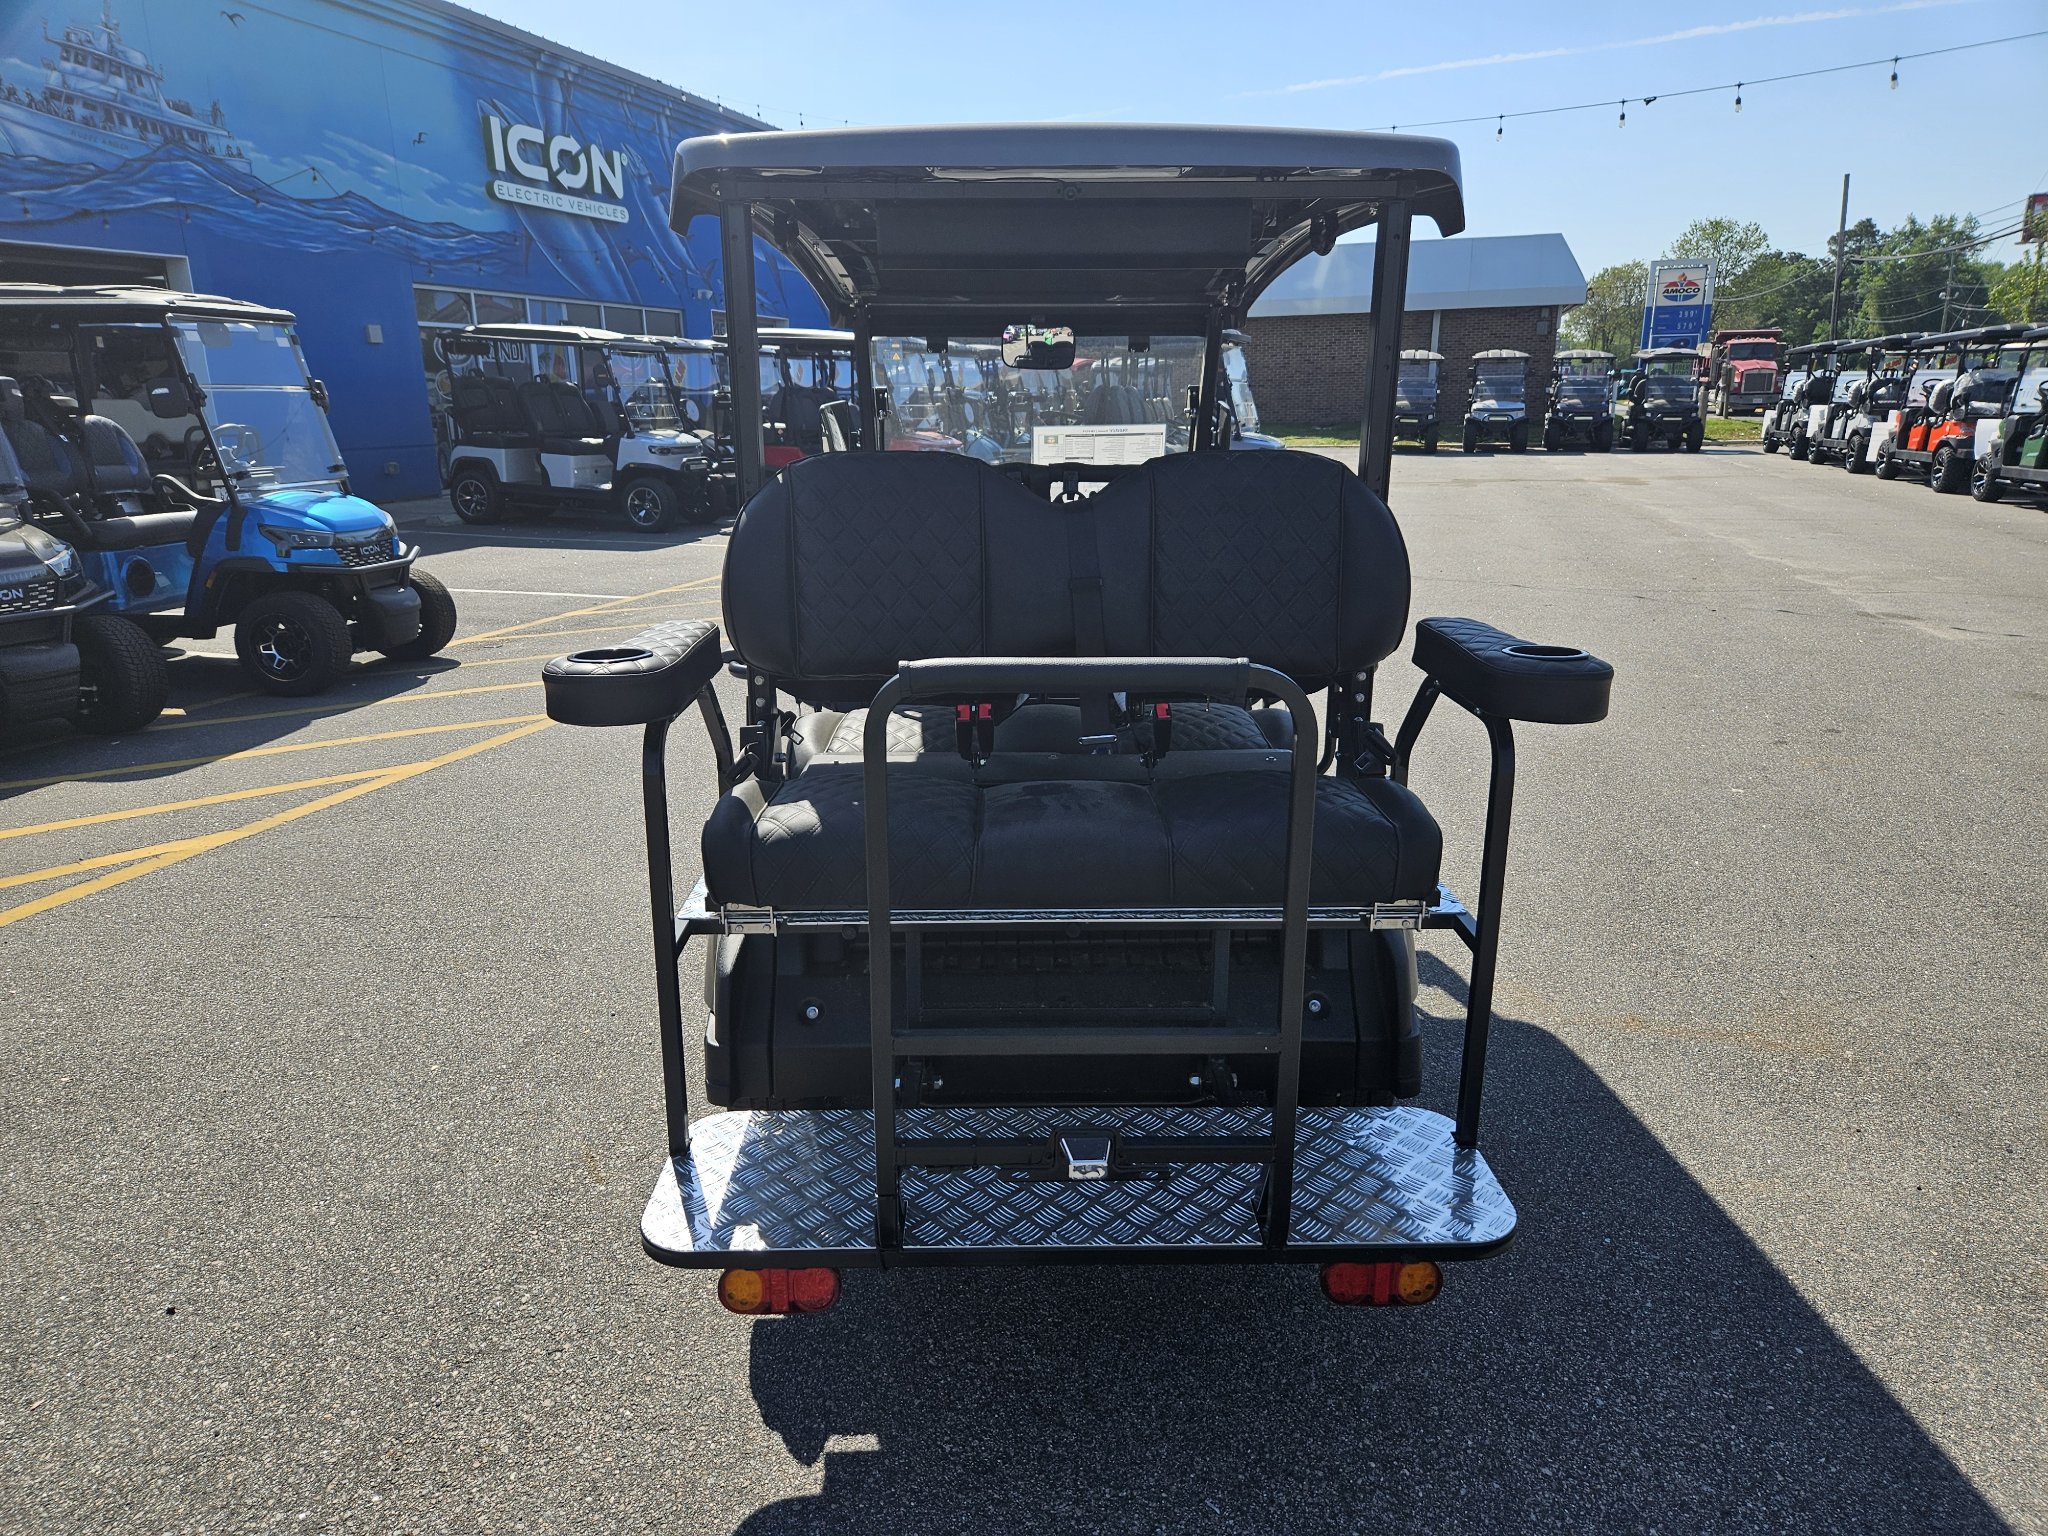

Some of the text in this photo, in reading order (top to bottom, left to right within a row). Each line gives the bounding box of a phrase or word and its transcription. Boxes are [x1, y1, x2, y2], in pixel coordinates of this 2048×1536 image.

[488, 115, 624, 200] ICON
[497, 184, 627, 220] ELECTRIC VEHICLES
[1662, 287, 1700, 295] AMOCO
[360, 544, 380, 555] ICON
